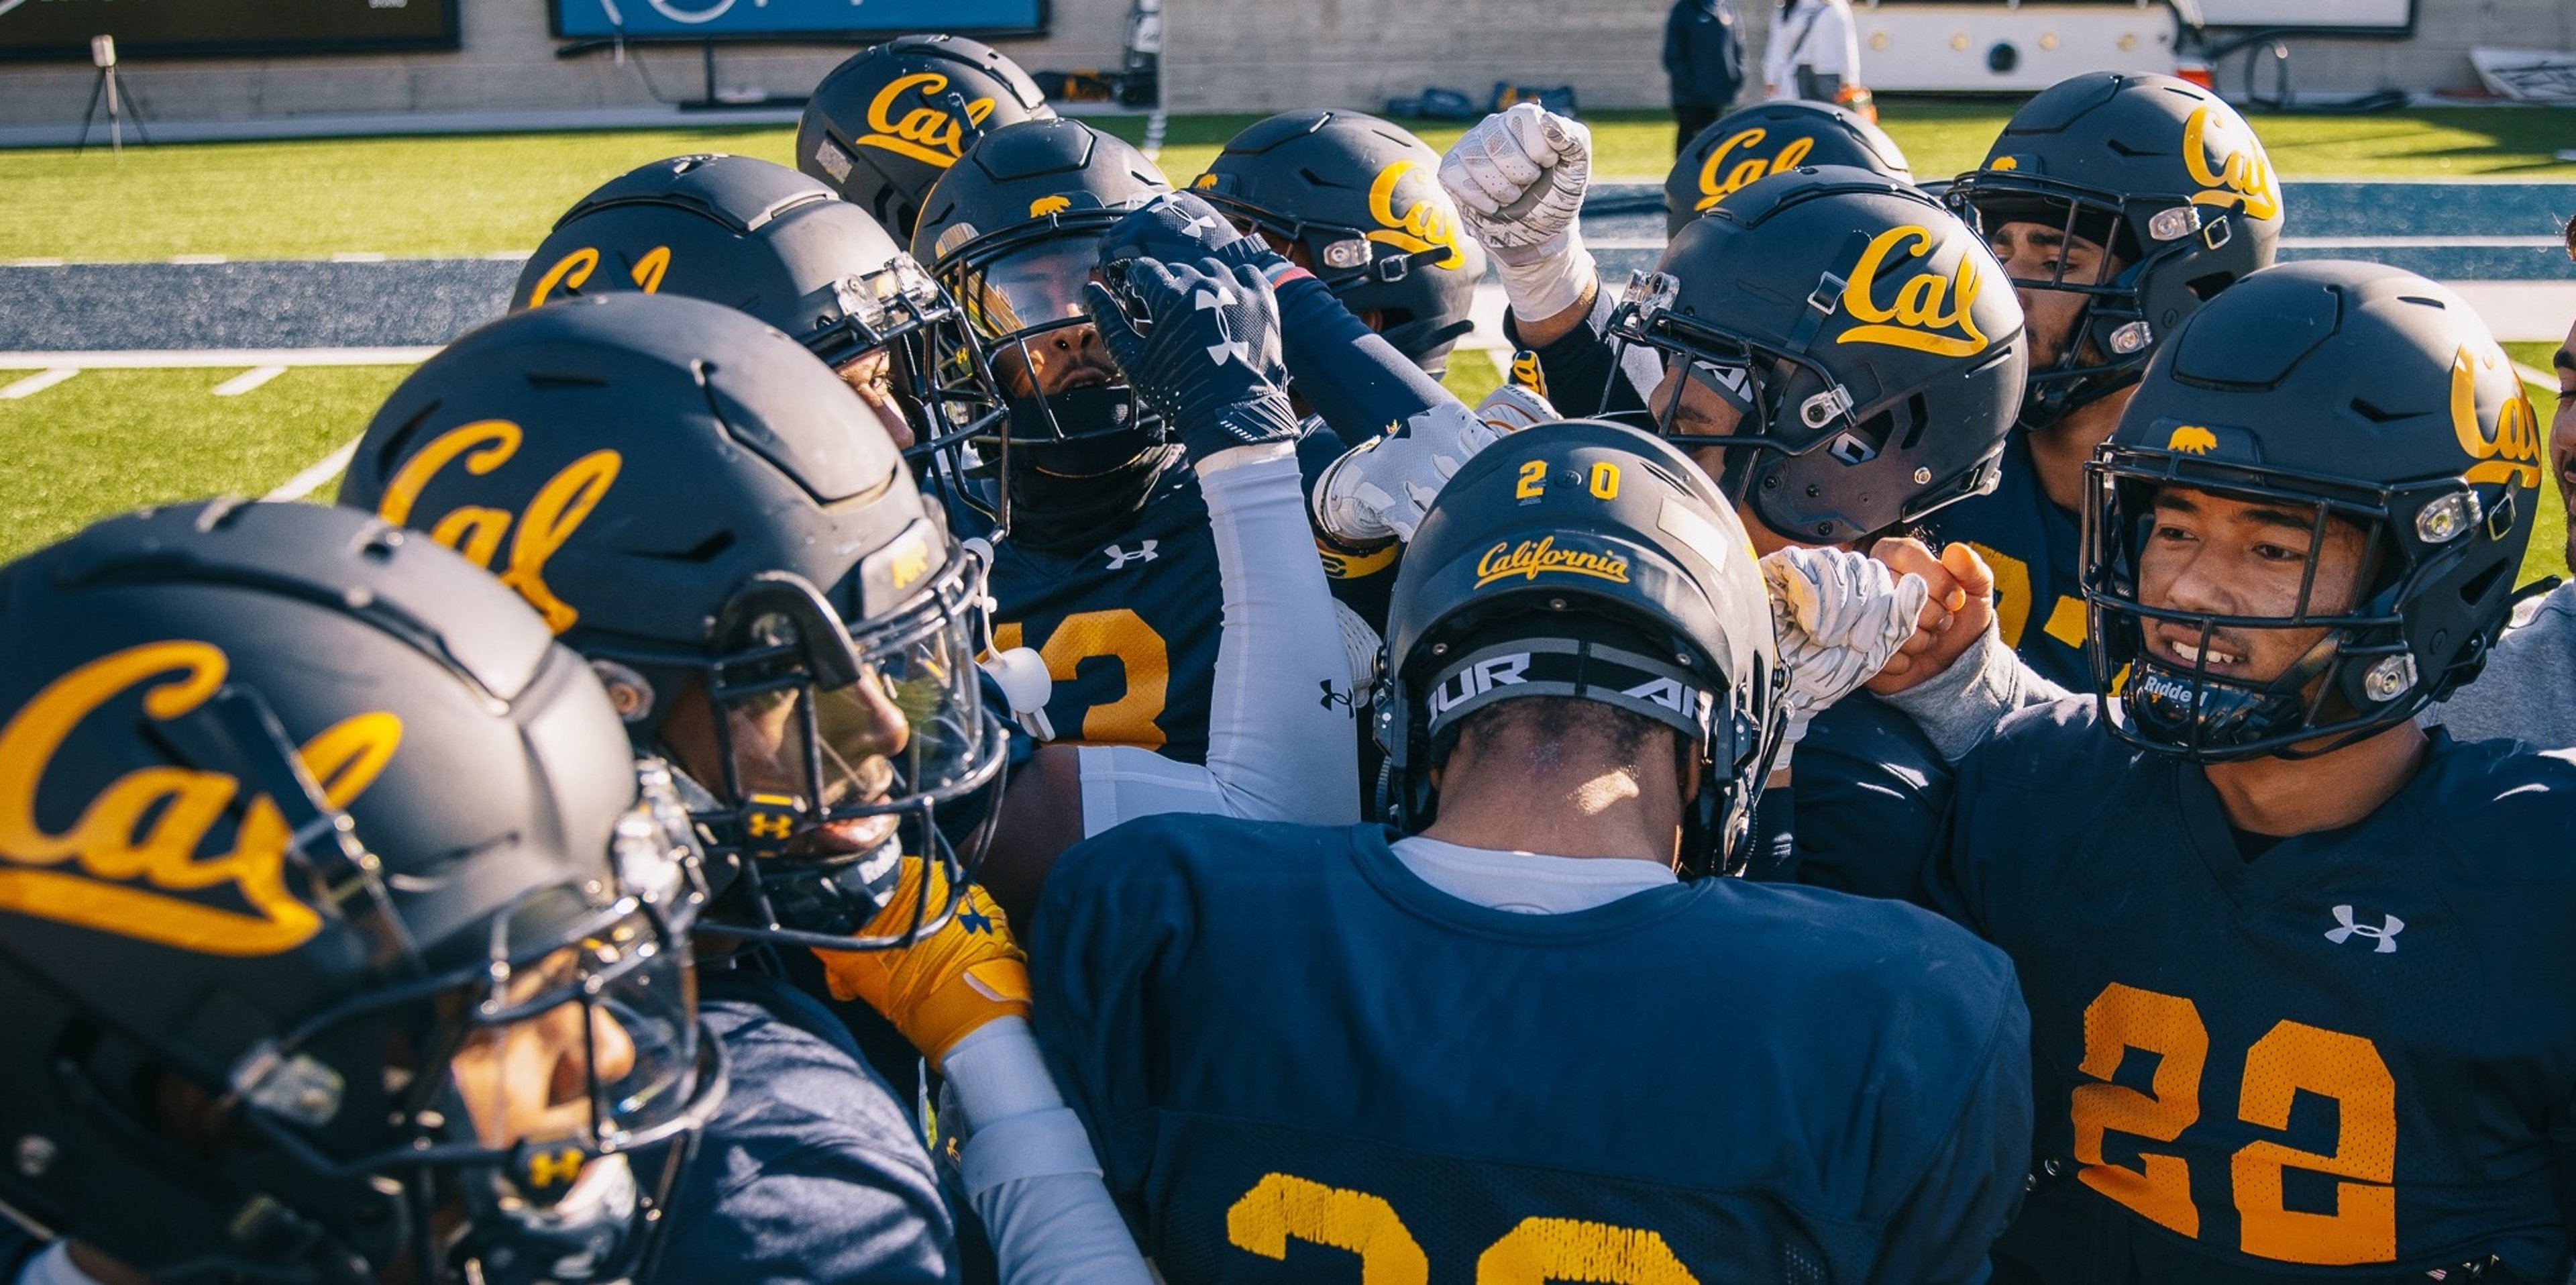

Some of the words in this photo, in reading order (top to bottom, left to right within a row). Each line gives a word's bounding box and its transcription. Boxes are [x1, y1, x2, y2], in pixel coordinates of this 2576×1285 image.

[855, 72, 996, 168] Cal
[2183, 105, 2277, 220] Cal
[1366, 159, 1465, 270] Cal
[1836, 225, 1988, 357] Cal
[2450, 342, 2542, 489] Cal
[379, 419, 623, 635] Cal
[1473, 535, 1630, 590] California
[2144, 676, 2209, 707] Riddel
[2070, 980, 2398, 1267] 22
